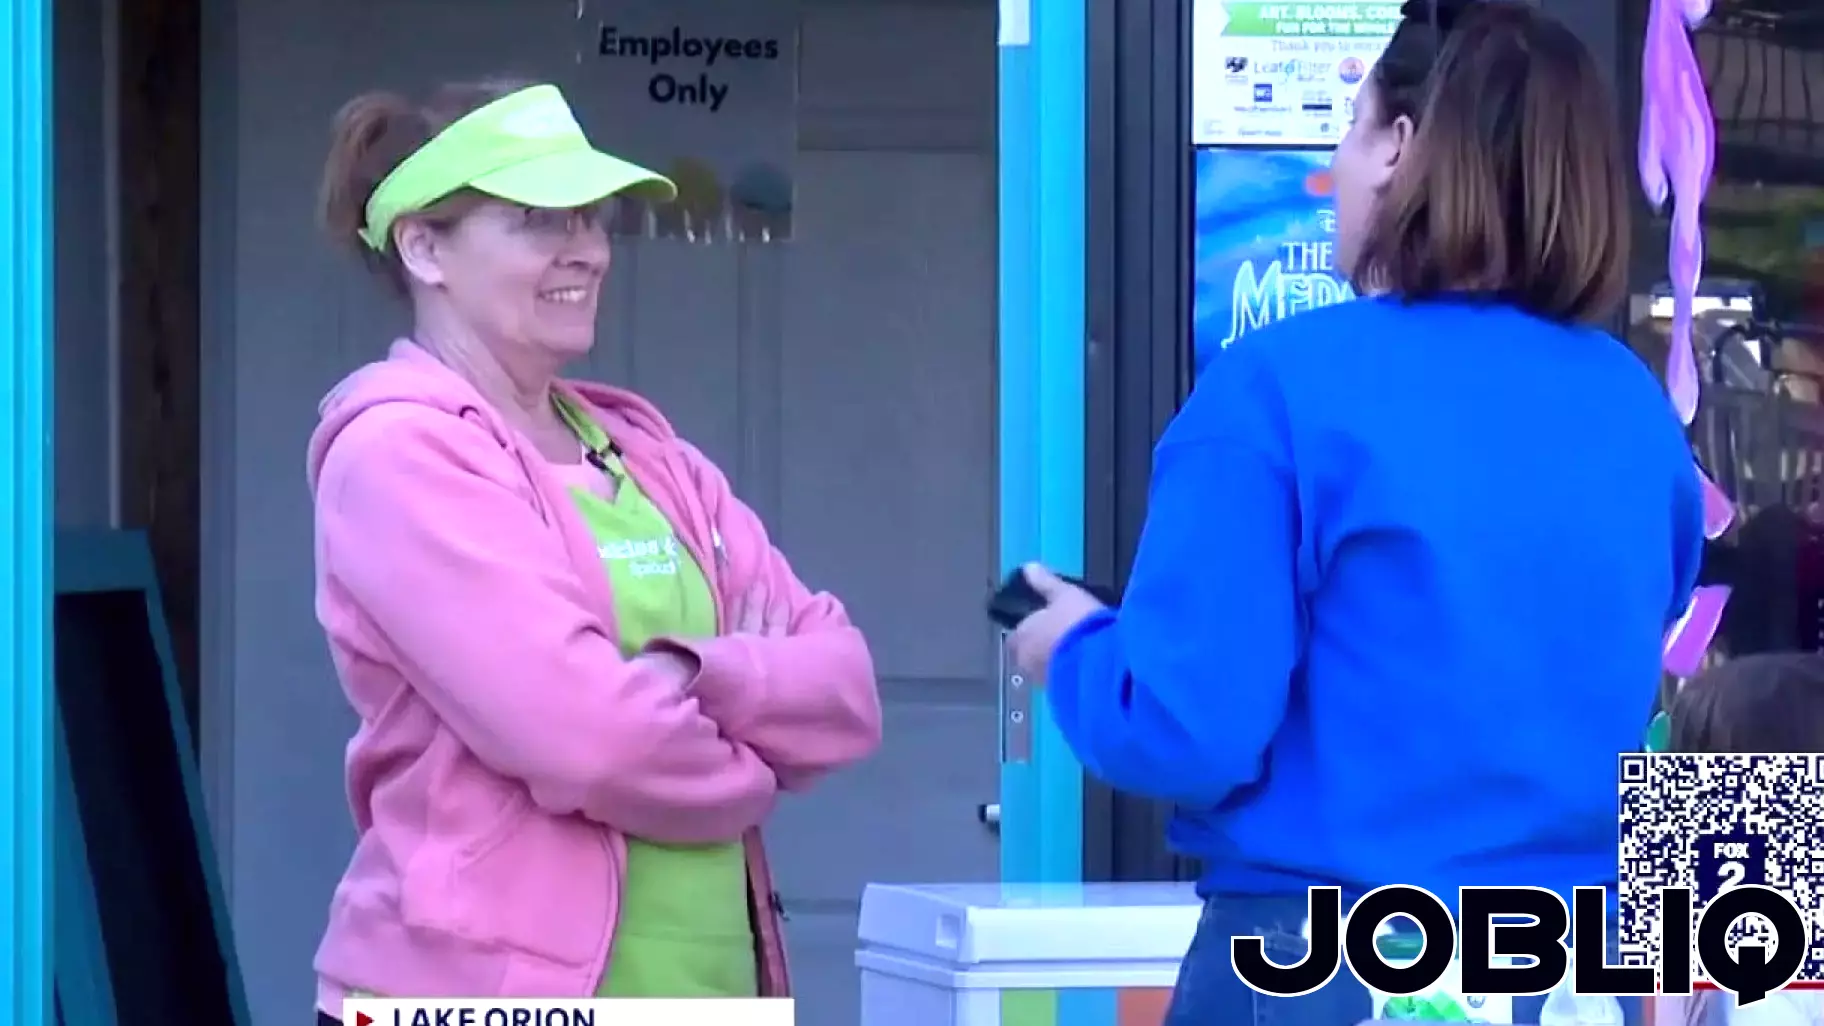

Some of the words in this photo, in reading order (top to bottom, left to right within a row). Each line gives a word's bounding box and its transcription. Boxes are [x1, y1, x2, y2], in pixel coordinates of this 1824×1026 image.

[600, 26, 779, 66] Employees
[648, 72, 728, 112] Only
[1283, 241, 1333, 271] THE
